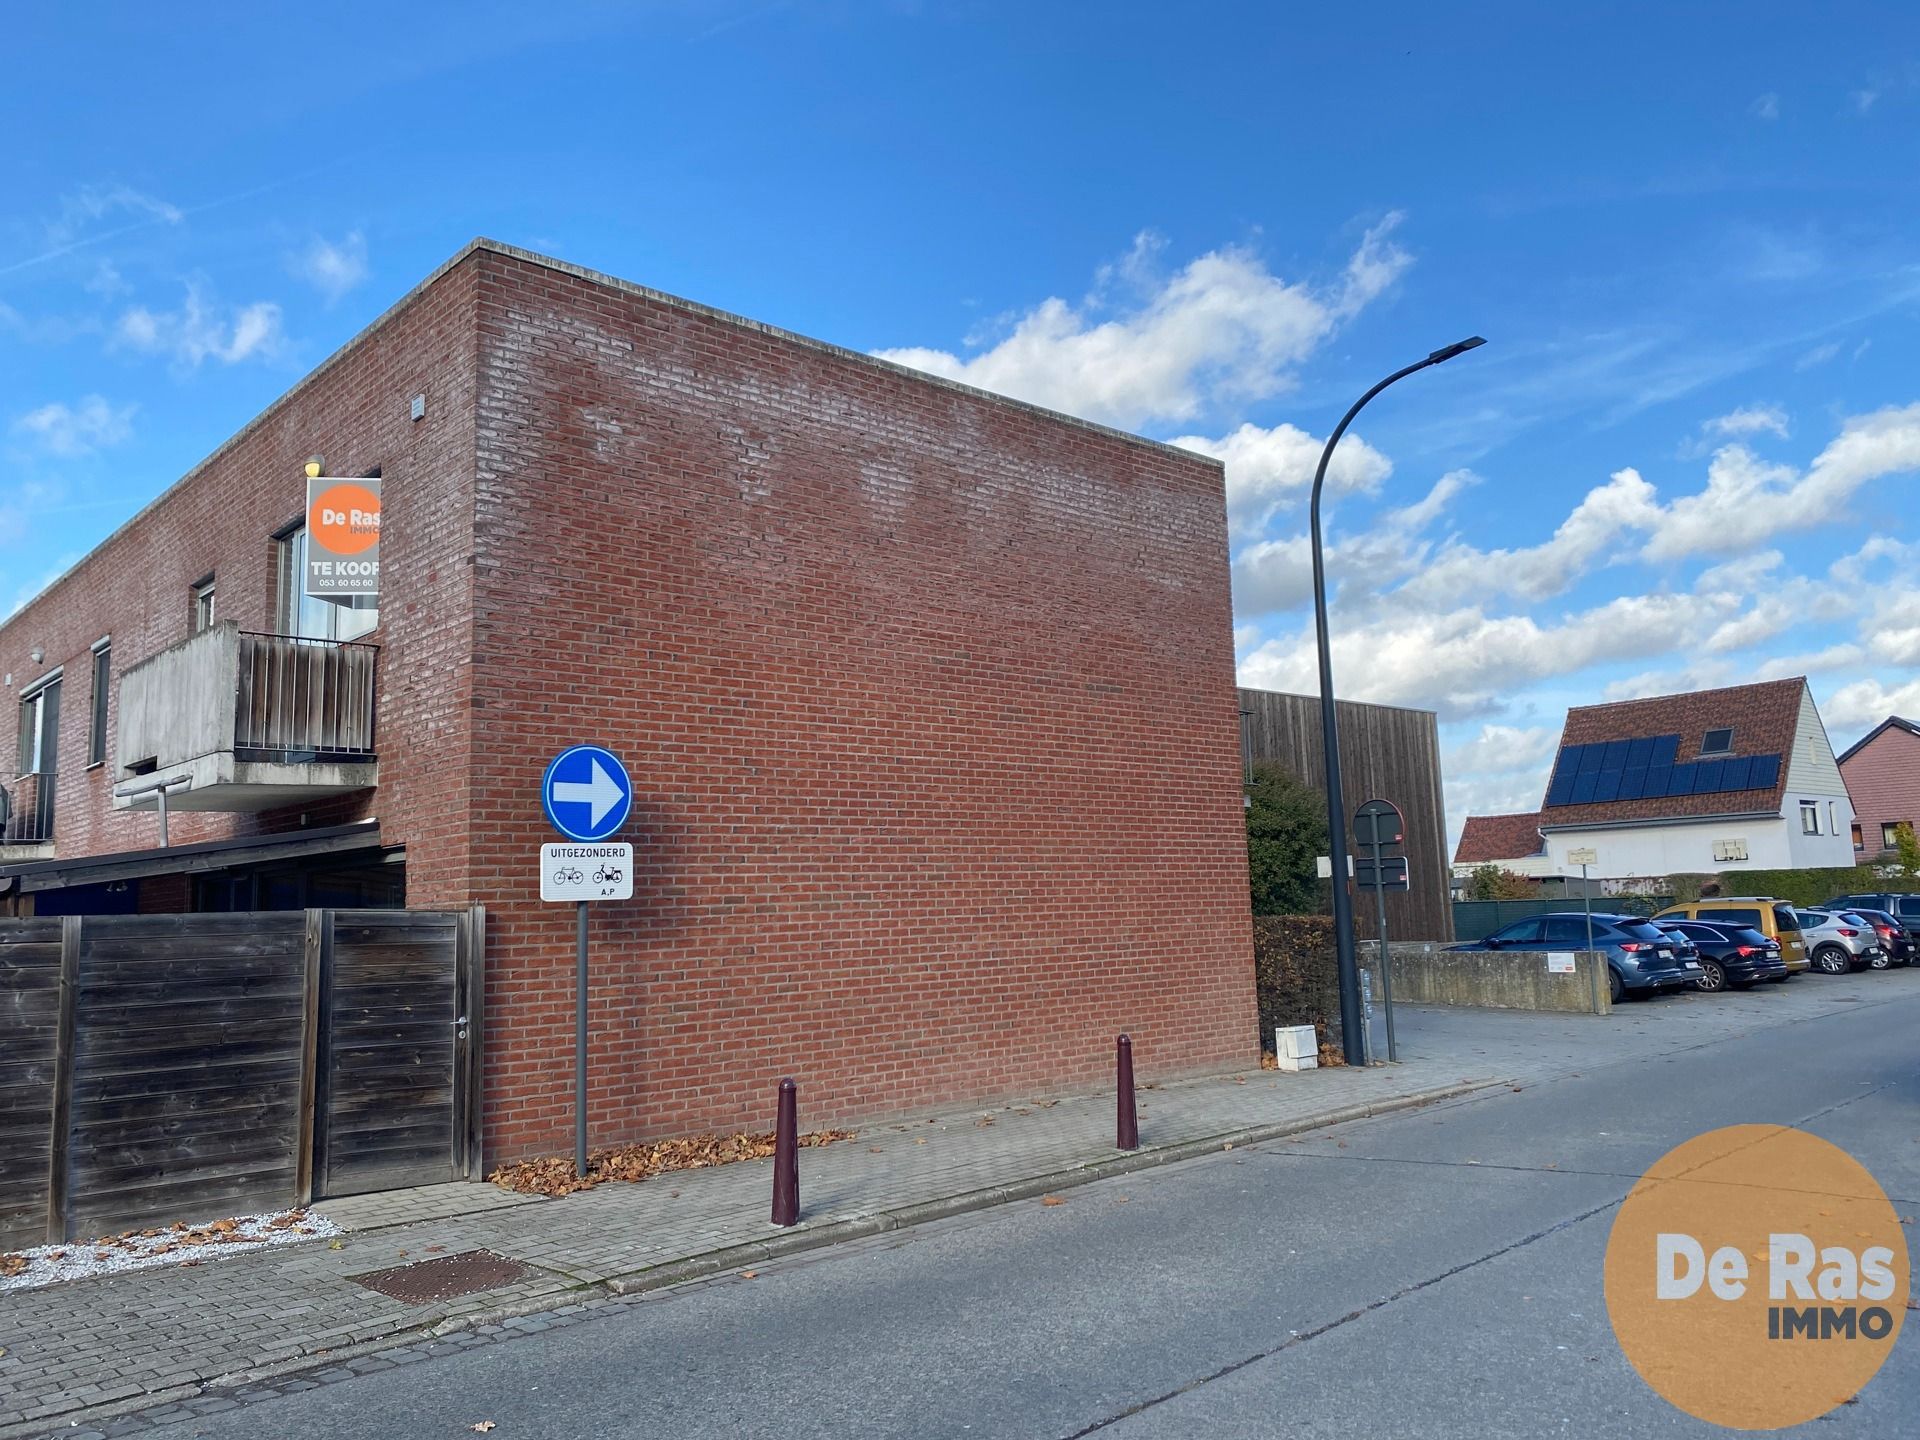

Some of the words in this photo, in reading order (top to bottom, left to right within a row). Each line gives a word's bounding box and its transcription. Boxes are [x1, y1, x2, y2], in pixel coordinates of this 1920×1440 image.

[322, 508, 346, 525] De
[350, 509, 381, 526] Ras
[311, 561, 333, 576] TE
[319, 579, 335, 587] 053
[337, 579, 349, 587] 60
[350, 579, 361, 587] 65
[362, 579, 374, 587] 60
[550, 848, 626, 858] UITGEZONDERD
